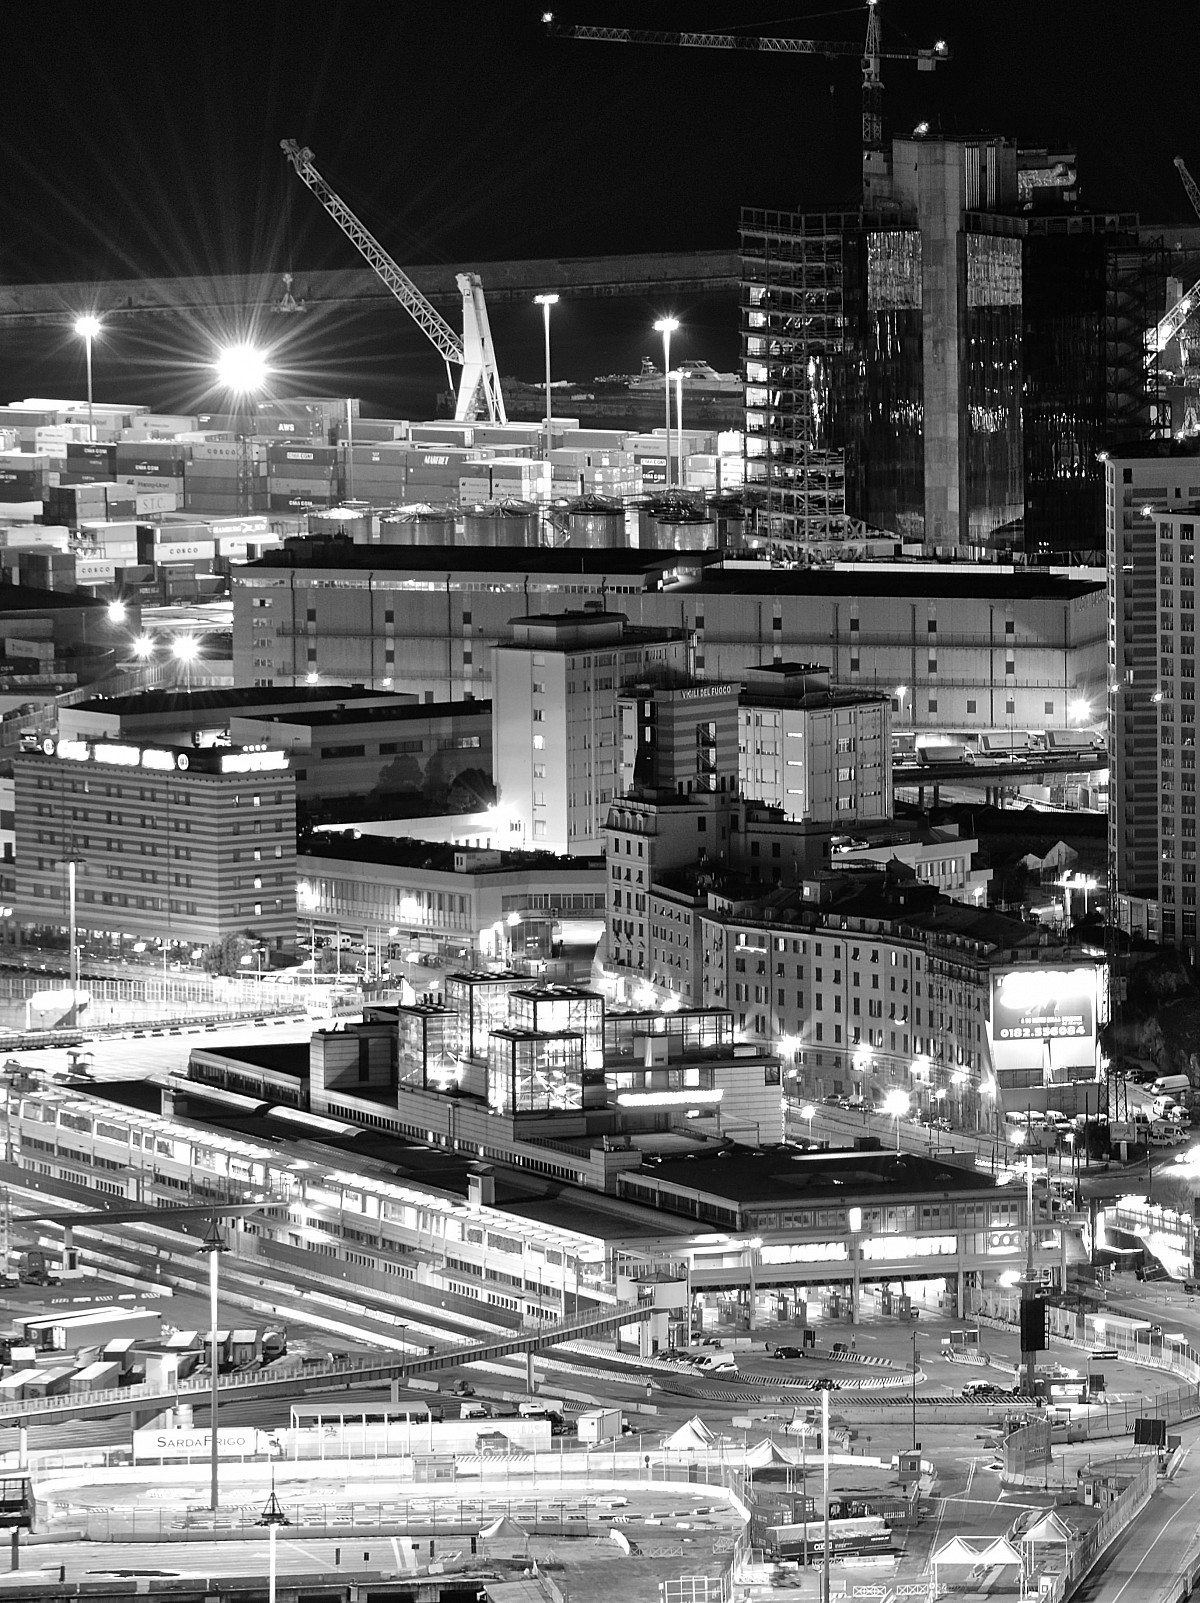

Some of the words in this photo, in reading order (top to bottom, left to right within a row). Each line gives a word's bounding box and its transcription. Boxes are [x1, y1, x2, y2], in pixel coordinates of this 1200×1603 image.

[278, 423, 295, 432] AWS
[170, 547, 198, 555] COSCO
[681, 689, 699, 699] VIGILI
[700, 688, 711, 697] DEL
[711, 685, 731, 695] FUOCO
